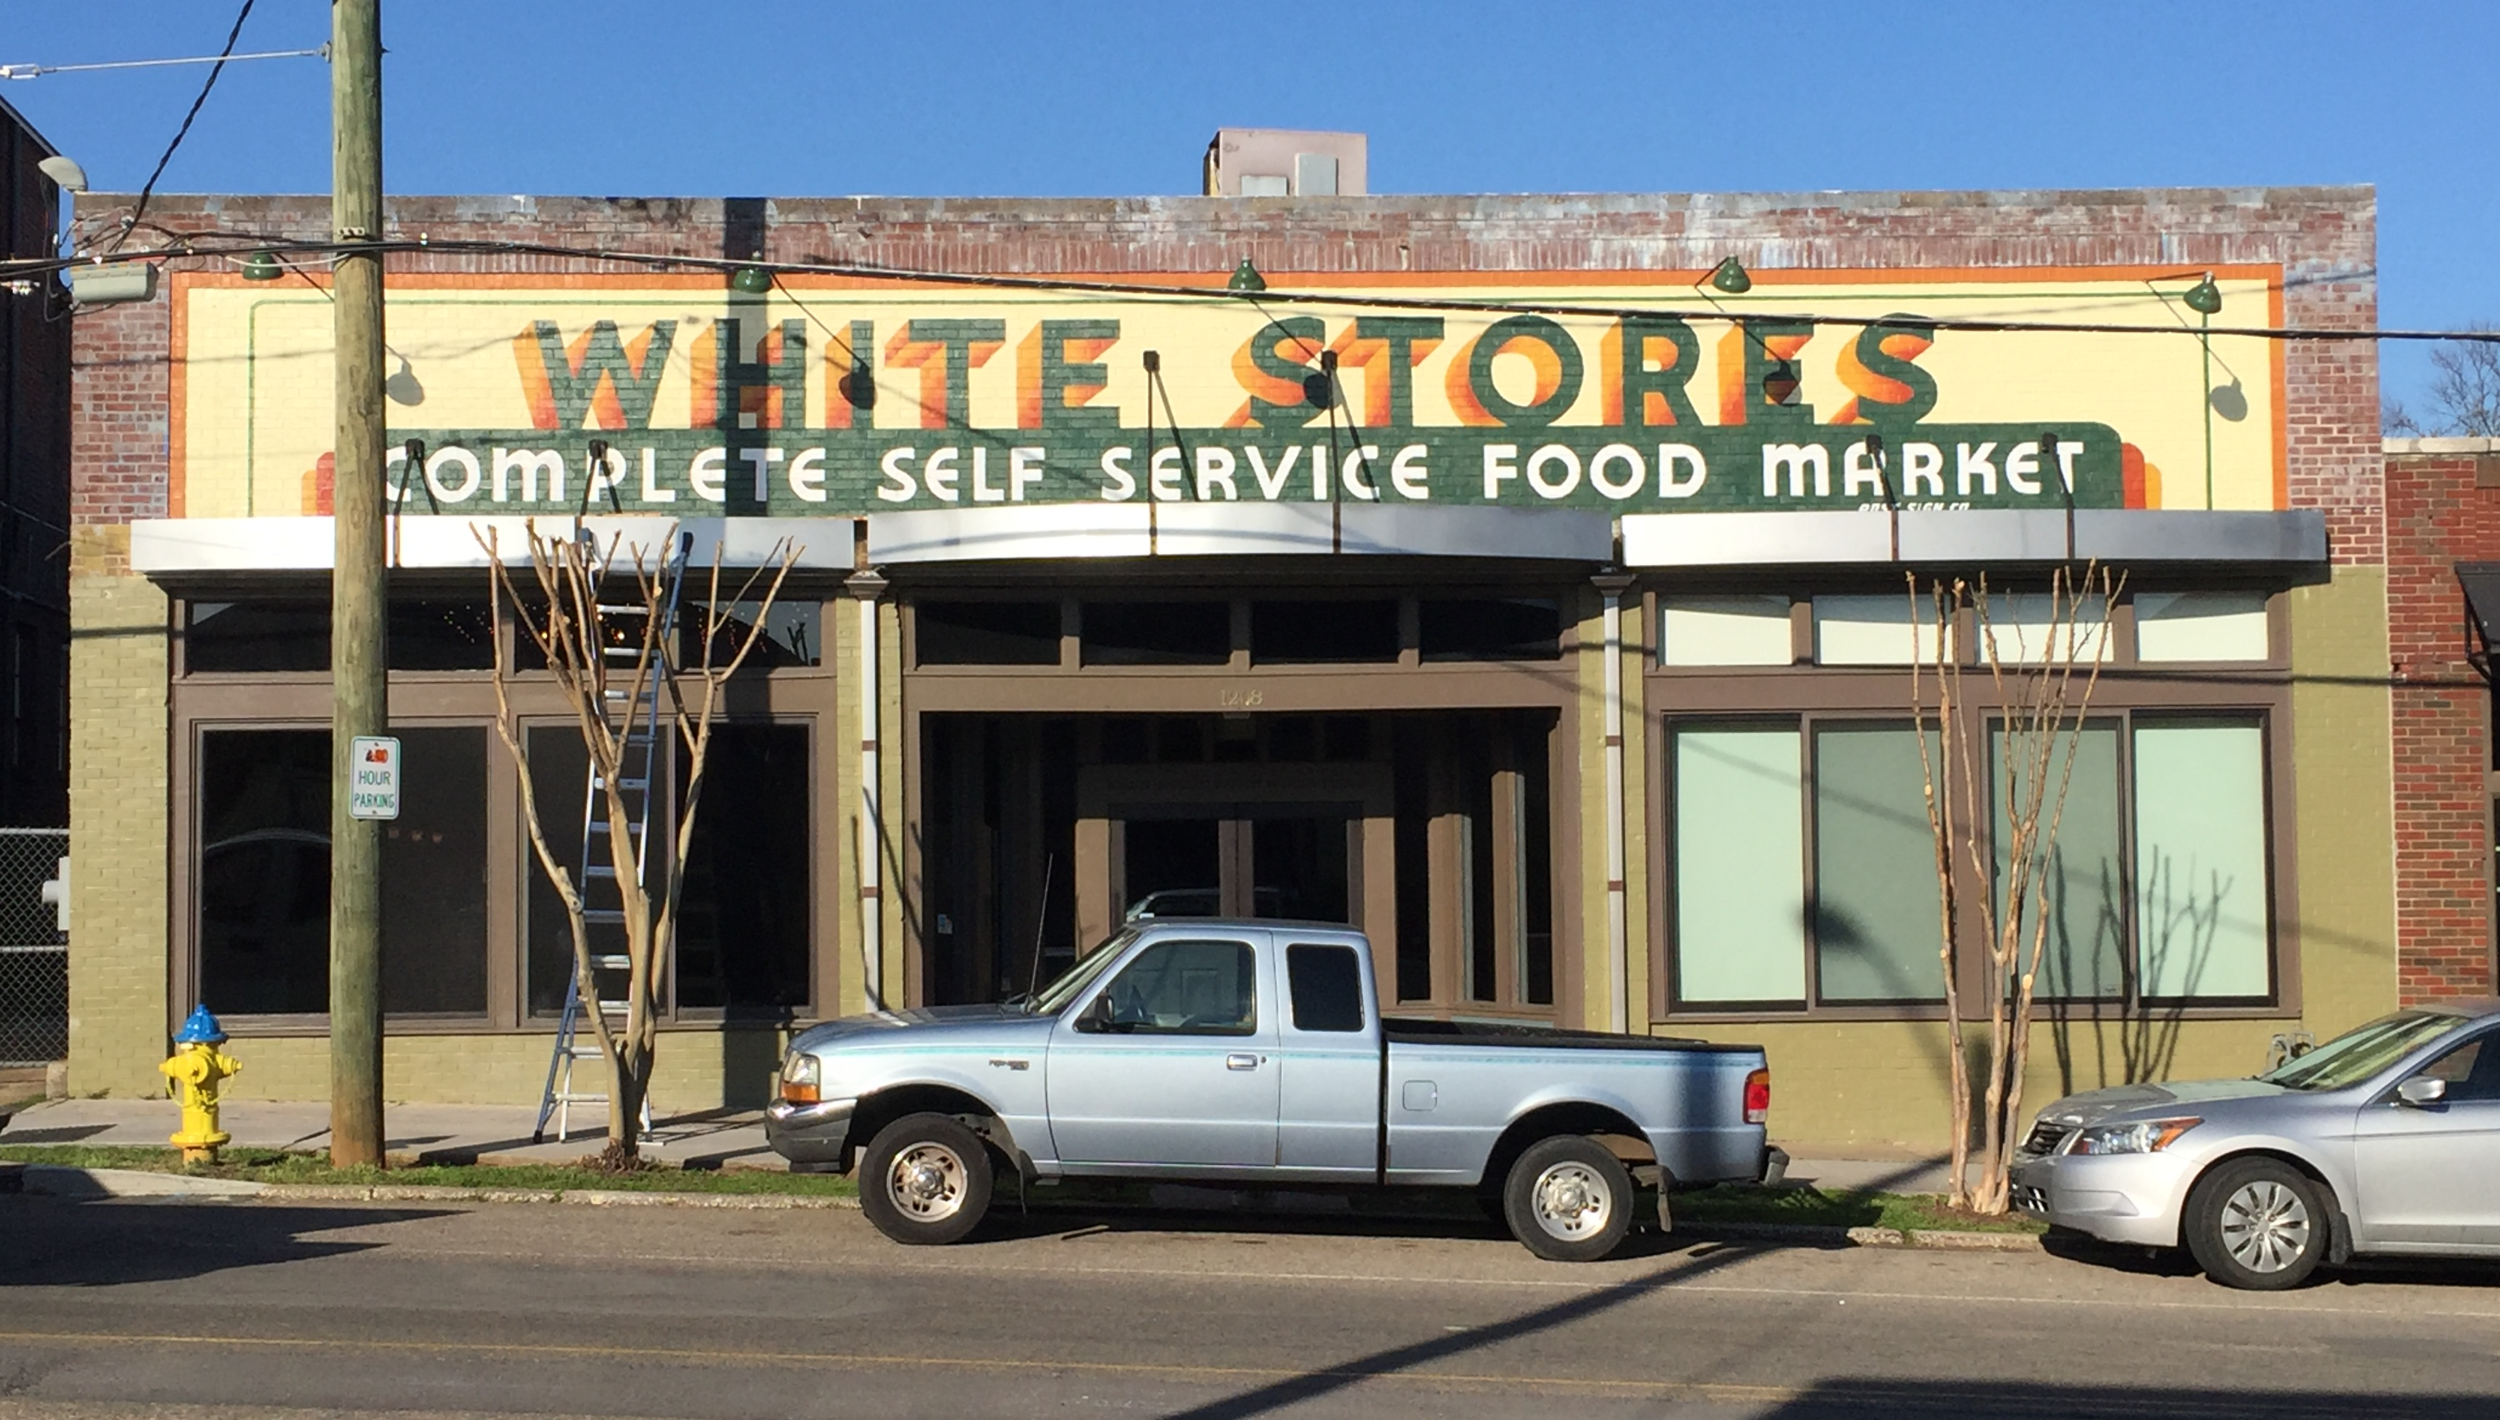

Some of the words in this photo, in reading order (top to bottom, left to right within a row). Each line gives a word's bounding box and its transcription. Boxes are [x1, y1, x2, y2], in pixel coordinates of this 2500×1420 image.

[512, 319, 1121, 430] WHITE
[1224, 312, 1938, 429] STORES
[386, 445, 827, 502] COMPLETE
[877, 446, 1046, 502] SELF
[1101, 444, 1429, 501] SERVICE
[1483, 443, 1707, 500] FOOD
[1762, 441, 2084, 497] MARKET
[358, 770, 391, 786] HOUR
[353, 792, 395, 809] PARKING
